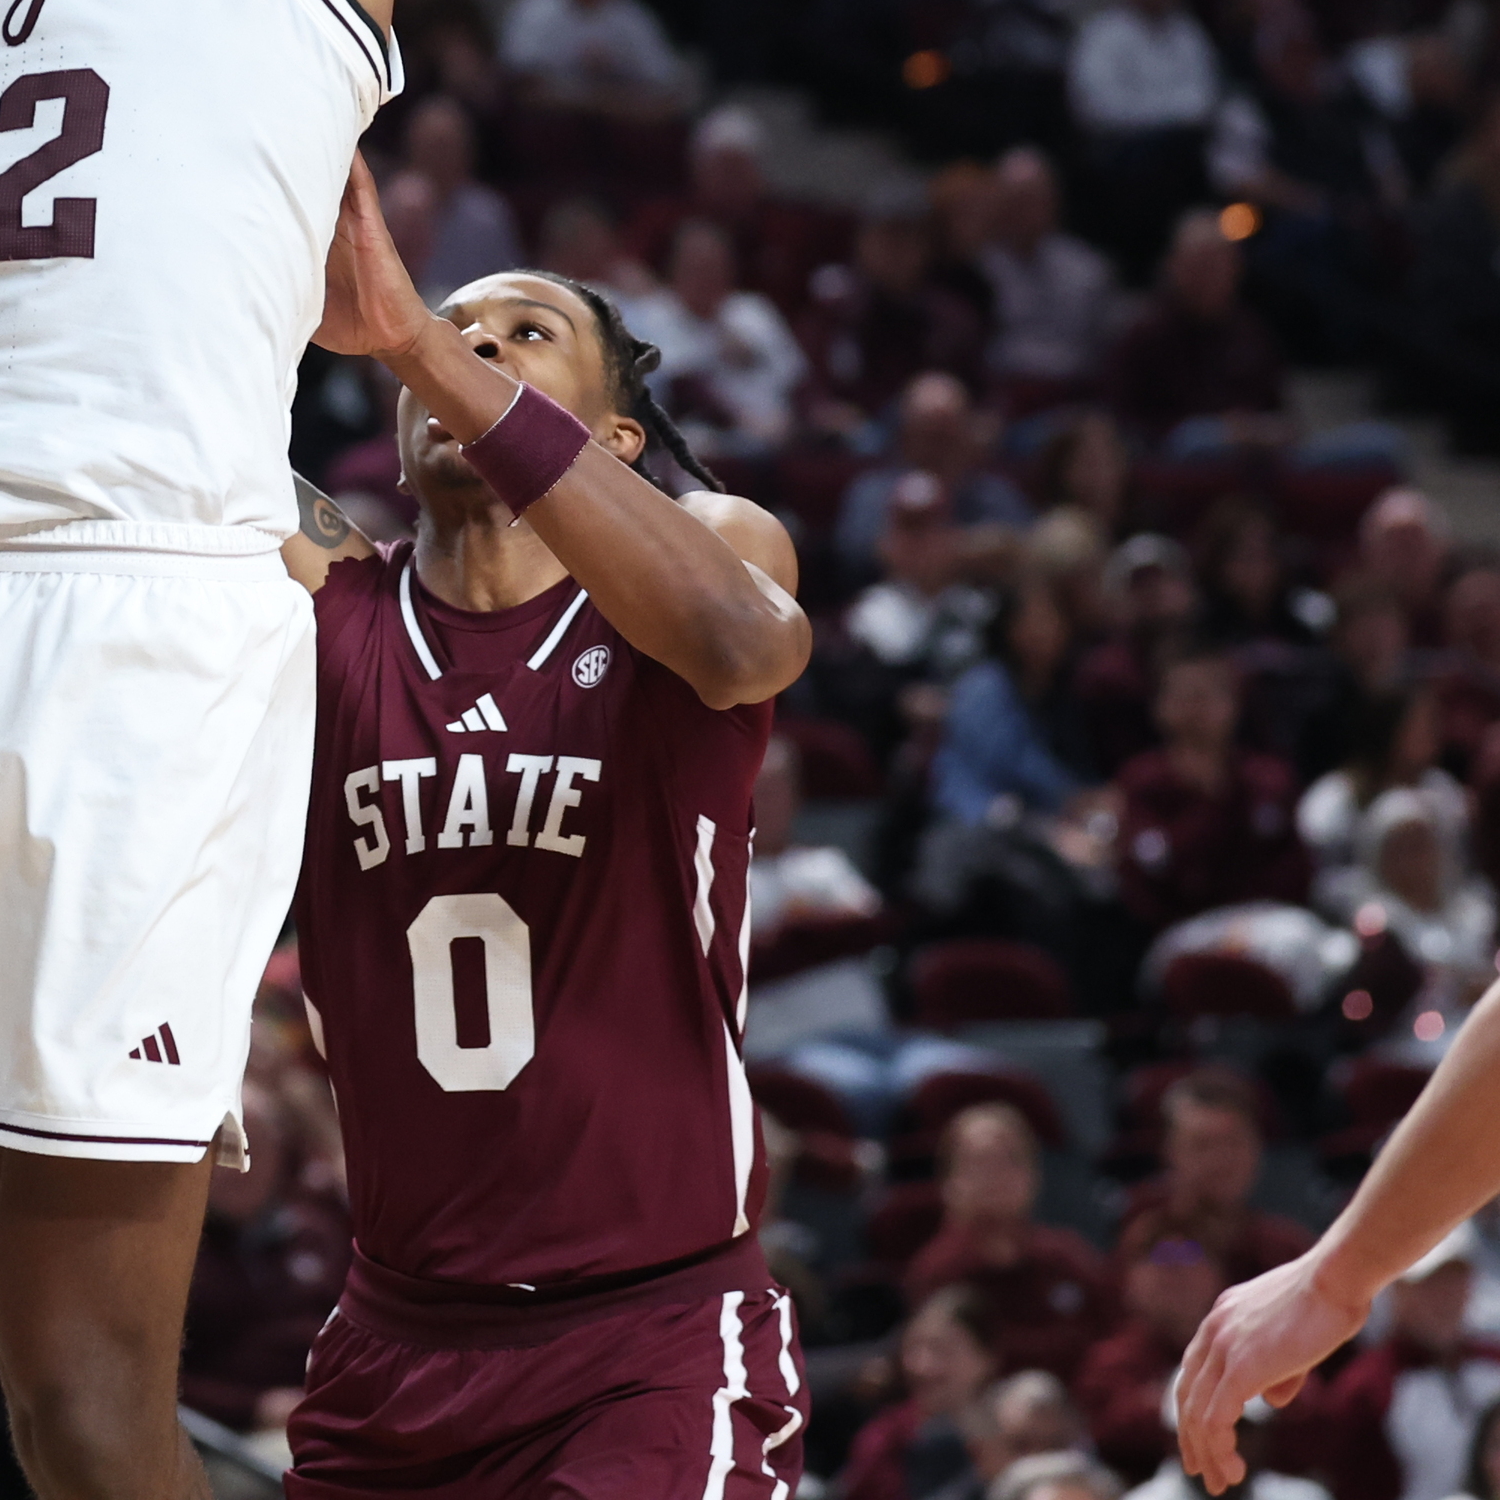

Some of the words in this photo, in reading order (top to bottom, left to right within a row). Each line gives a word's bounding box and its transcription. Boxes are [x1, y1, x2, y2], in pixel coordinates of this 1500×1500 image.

[577, 649, 608, 685] SEC
[343, 753, 602, 872] STATE
[405, 892, 536, 1093] 0
